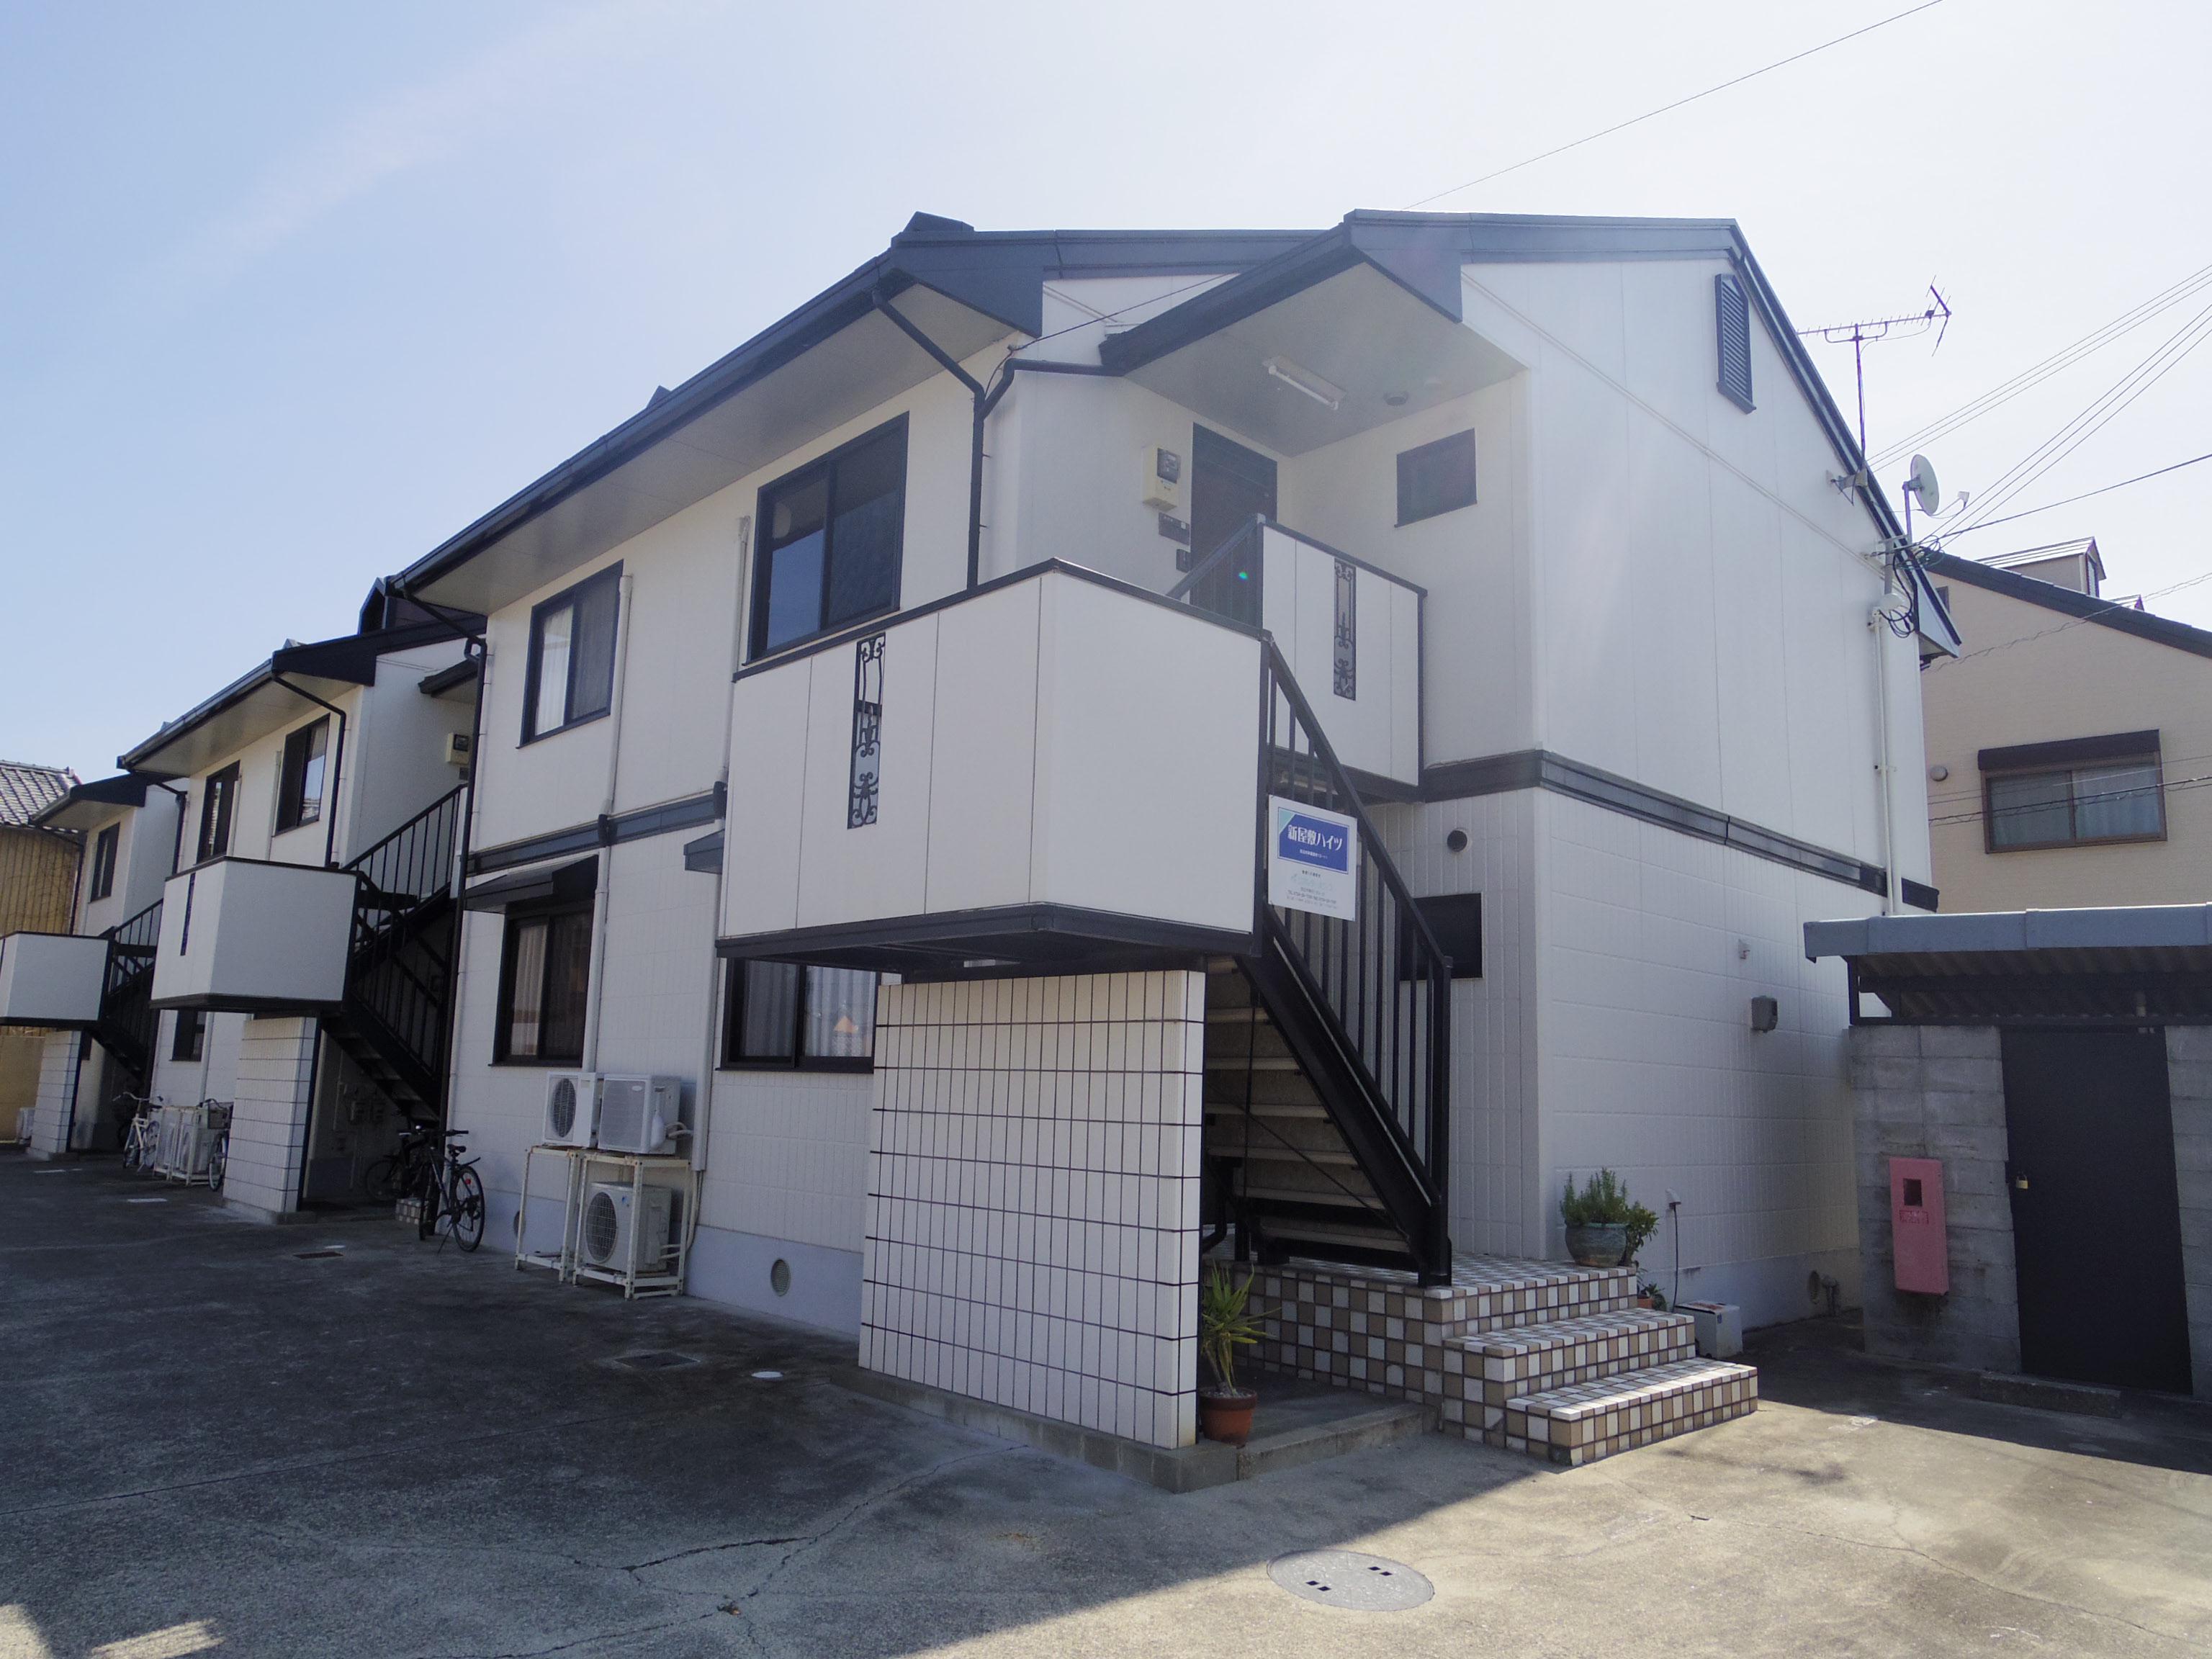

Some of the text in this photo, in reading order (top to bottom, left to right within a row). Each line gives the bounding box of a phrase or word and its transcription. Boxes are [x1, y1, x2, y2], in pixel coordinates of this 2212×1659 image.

[1287, 824, 1342, 851] 新屋敷ハイツ
